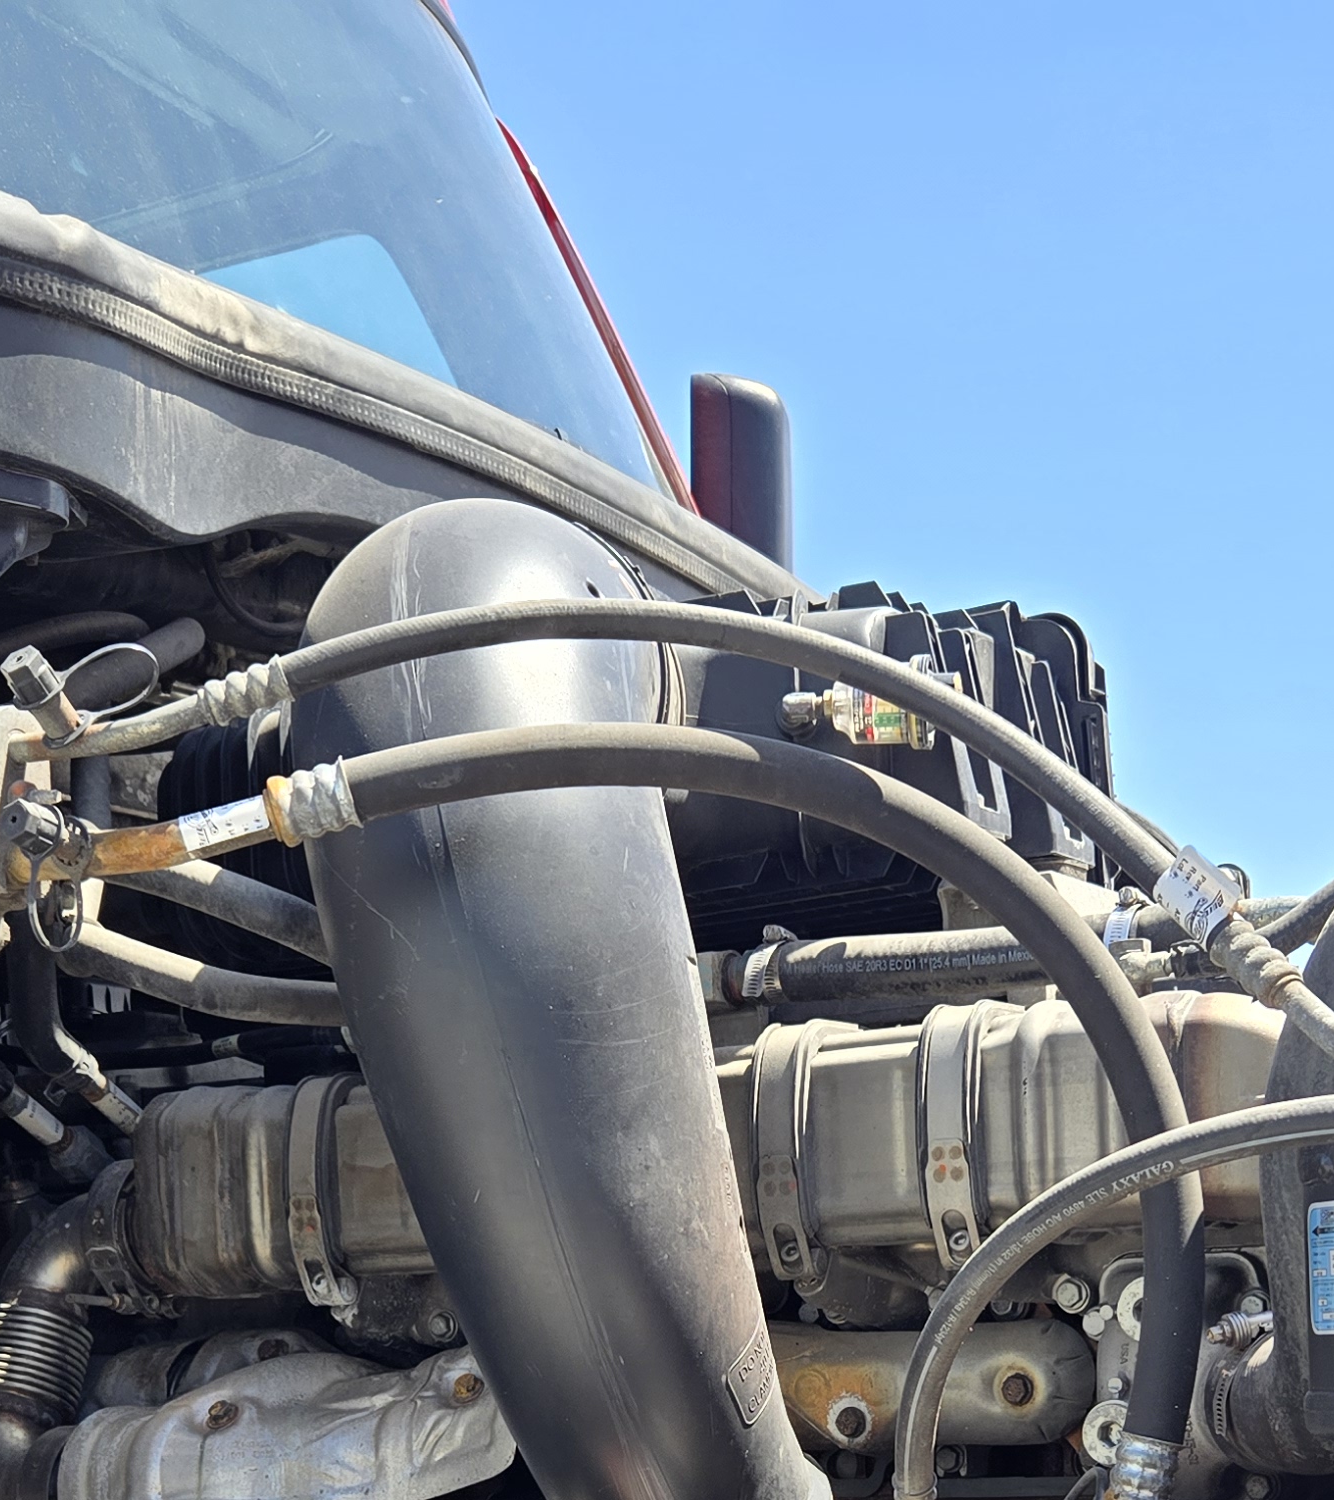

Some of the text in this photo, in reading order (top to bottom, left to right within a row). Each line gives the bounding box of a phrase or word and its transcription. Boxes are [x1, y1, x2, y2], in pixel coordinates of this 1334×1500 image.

[822, 960, 844, 973] Hose
[845, 959, 863, 972] SAE
[865, 957, 888, 972] 20R3
[889, 957, 903, 971] EC
[973, 954, 995, 966] Made
[997, 953, 1007, 965] in
[1111, 1160, 1175, 1194] GALAXY
[1085, 1186, 1109, 1205] SLE
[1020, 1220, 1049, 1246] HOSE
[1120, 1343, 1129, 1364] USA
